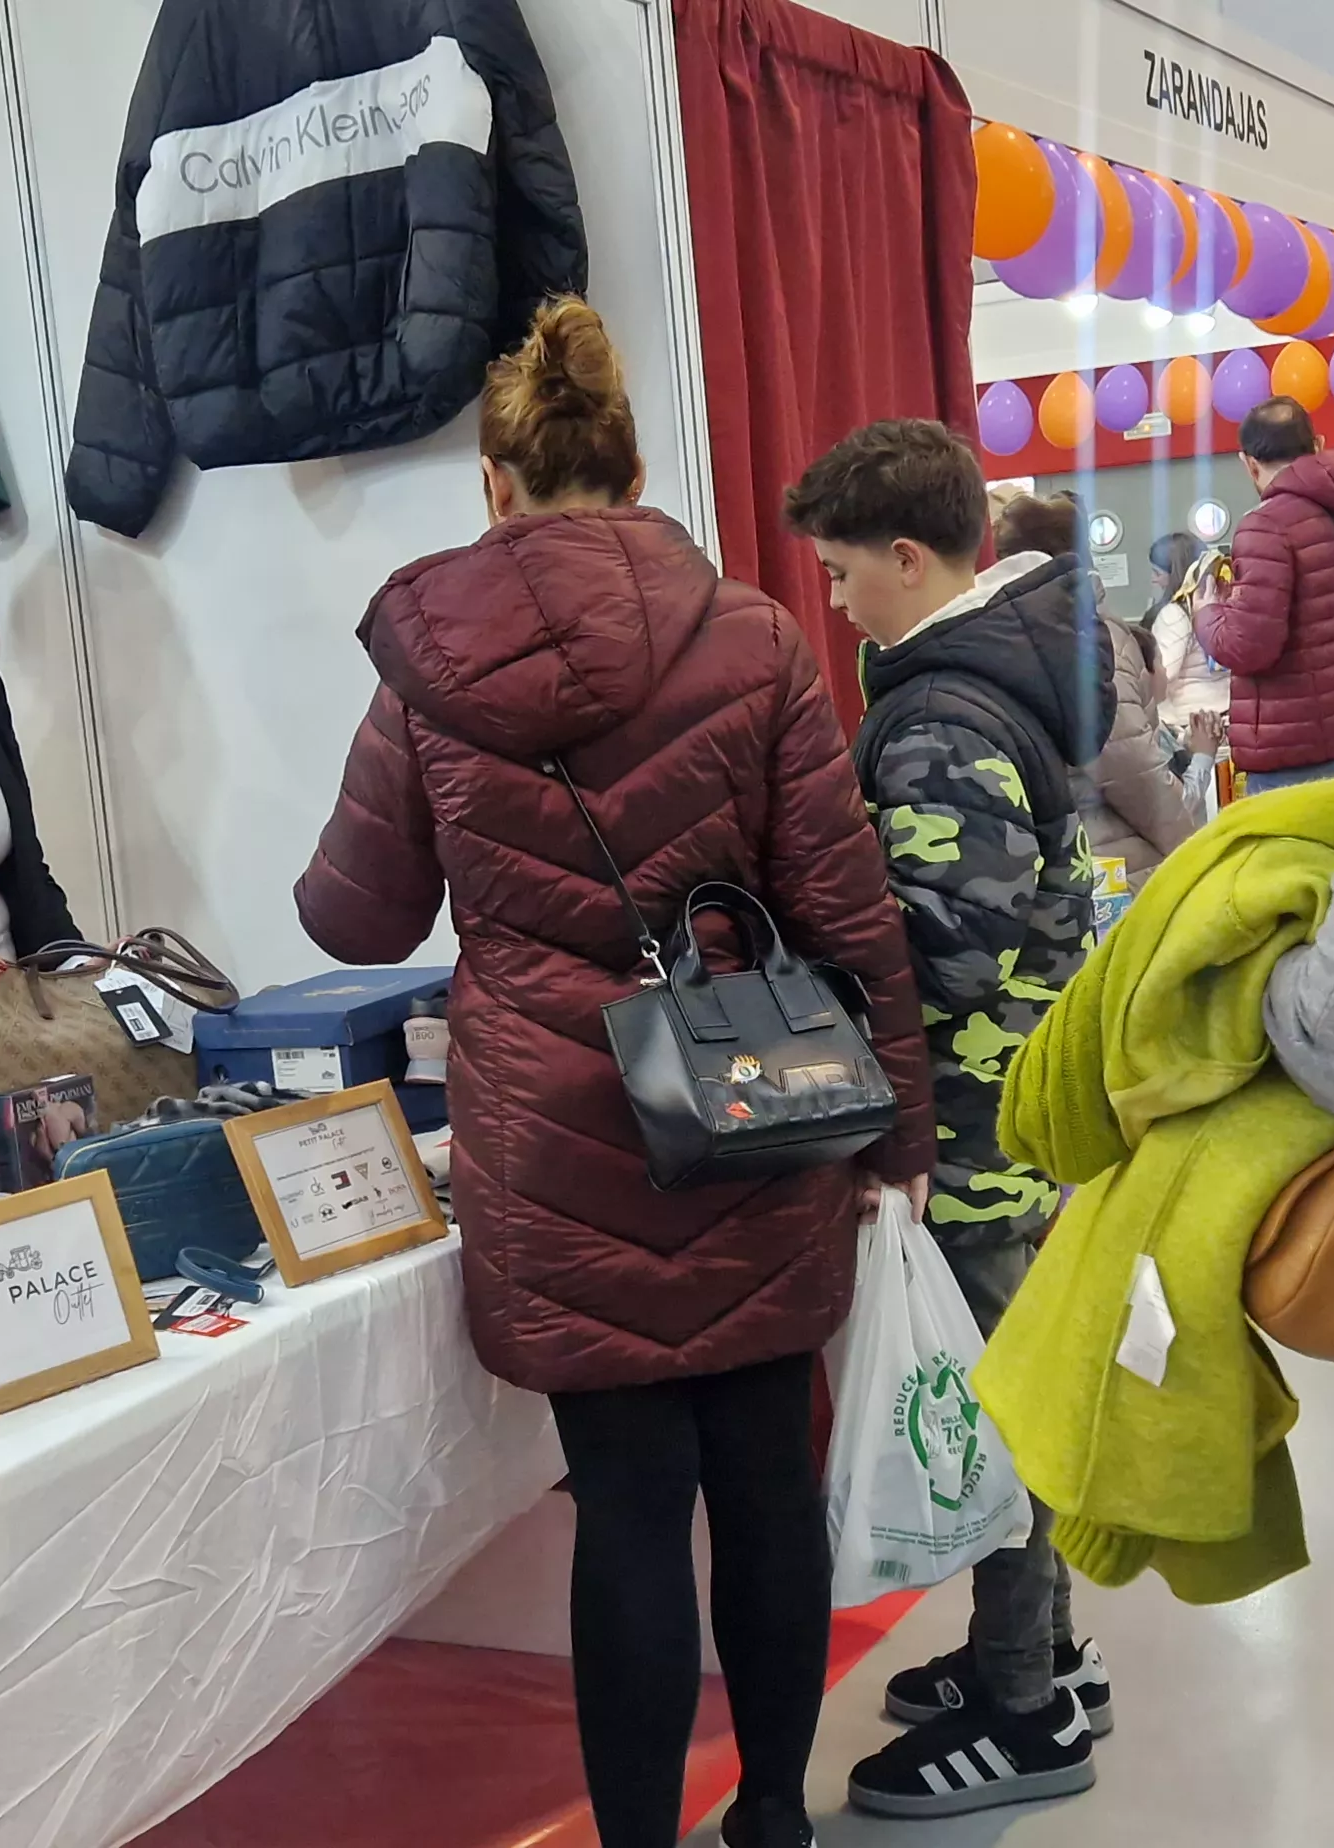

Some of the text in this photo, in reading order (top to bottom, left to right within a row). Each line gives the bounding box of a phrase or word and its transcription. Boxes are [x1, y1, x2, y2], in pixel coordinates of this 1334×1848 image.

[1143, 49, 1269, 150] ZARANDAJAS
[180, 136, 292, 194] Calvin
[295, 100, 399, 156] Klein
[8, 1260, 99, 1305] PALACE
[53, 1282, 105, 1326] Outlet
[893, 1373, 918, 1438] REDUCE
